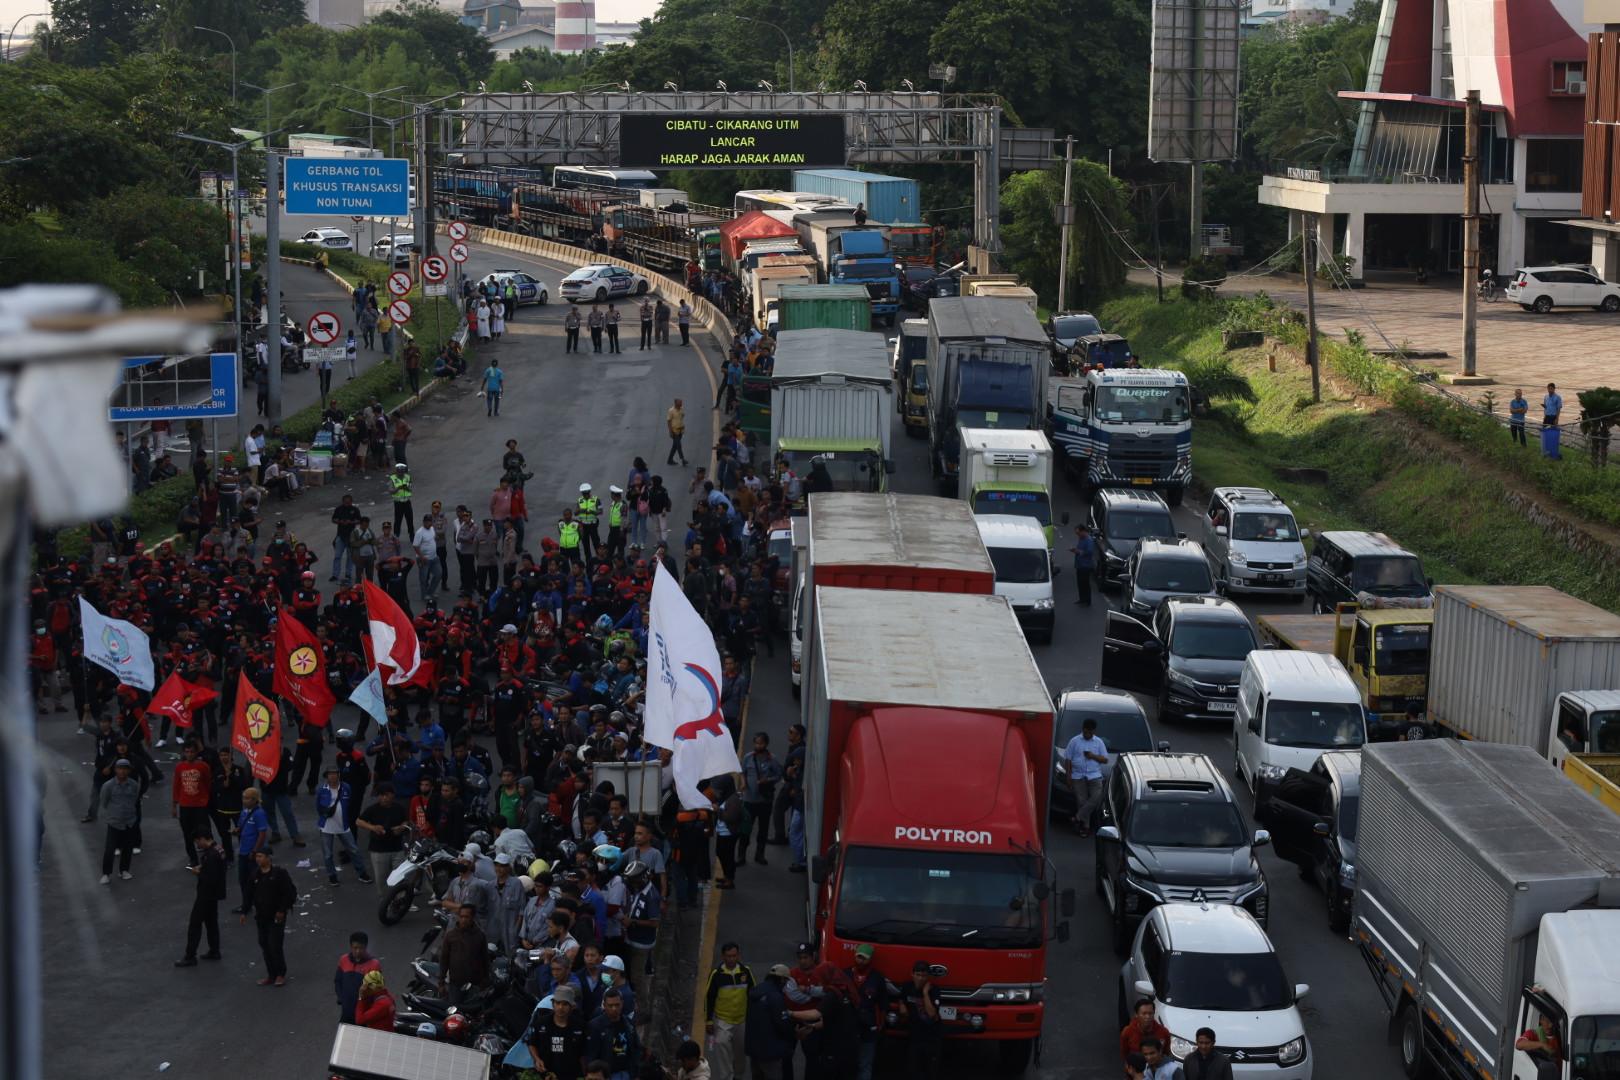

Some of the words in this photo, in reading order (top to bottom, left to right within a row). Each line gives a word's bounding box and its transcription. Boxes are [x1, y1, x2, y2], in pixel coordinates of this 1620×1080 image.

[666, 120, 707, 130] CIBATU
[716, 120, 773, 130] CIKARANG
[776, 120, 799, 130] UTM
[710, 137, 755, 147] LANCAR
[661, 154, 698, 164] HARAP
[701, 154, 731, 164] JAGA
[733, 154, 770, 164] JARAK
[772, 153, 805, 163] AMAN
[307, 166, 360, 176] GERBANG
[362, 167, 384, 176] TOL
[293, 182, 338, 192] KHUSUS
[341, 182, 402, 193] TRANSAKSI
[317, 198, 339, 207] NON
[341, 198, 372, 208] TUNAI
[1116, 388, 1170, 397] Quester
[895, 826, 992, 845] POLYTRON
